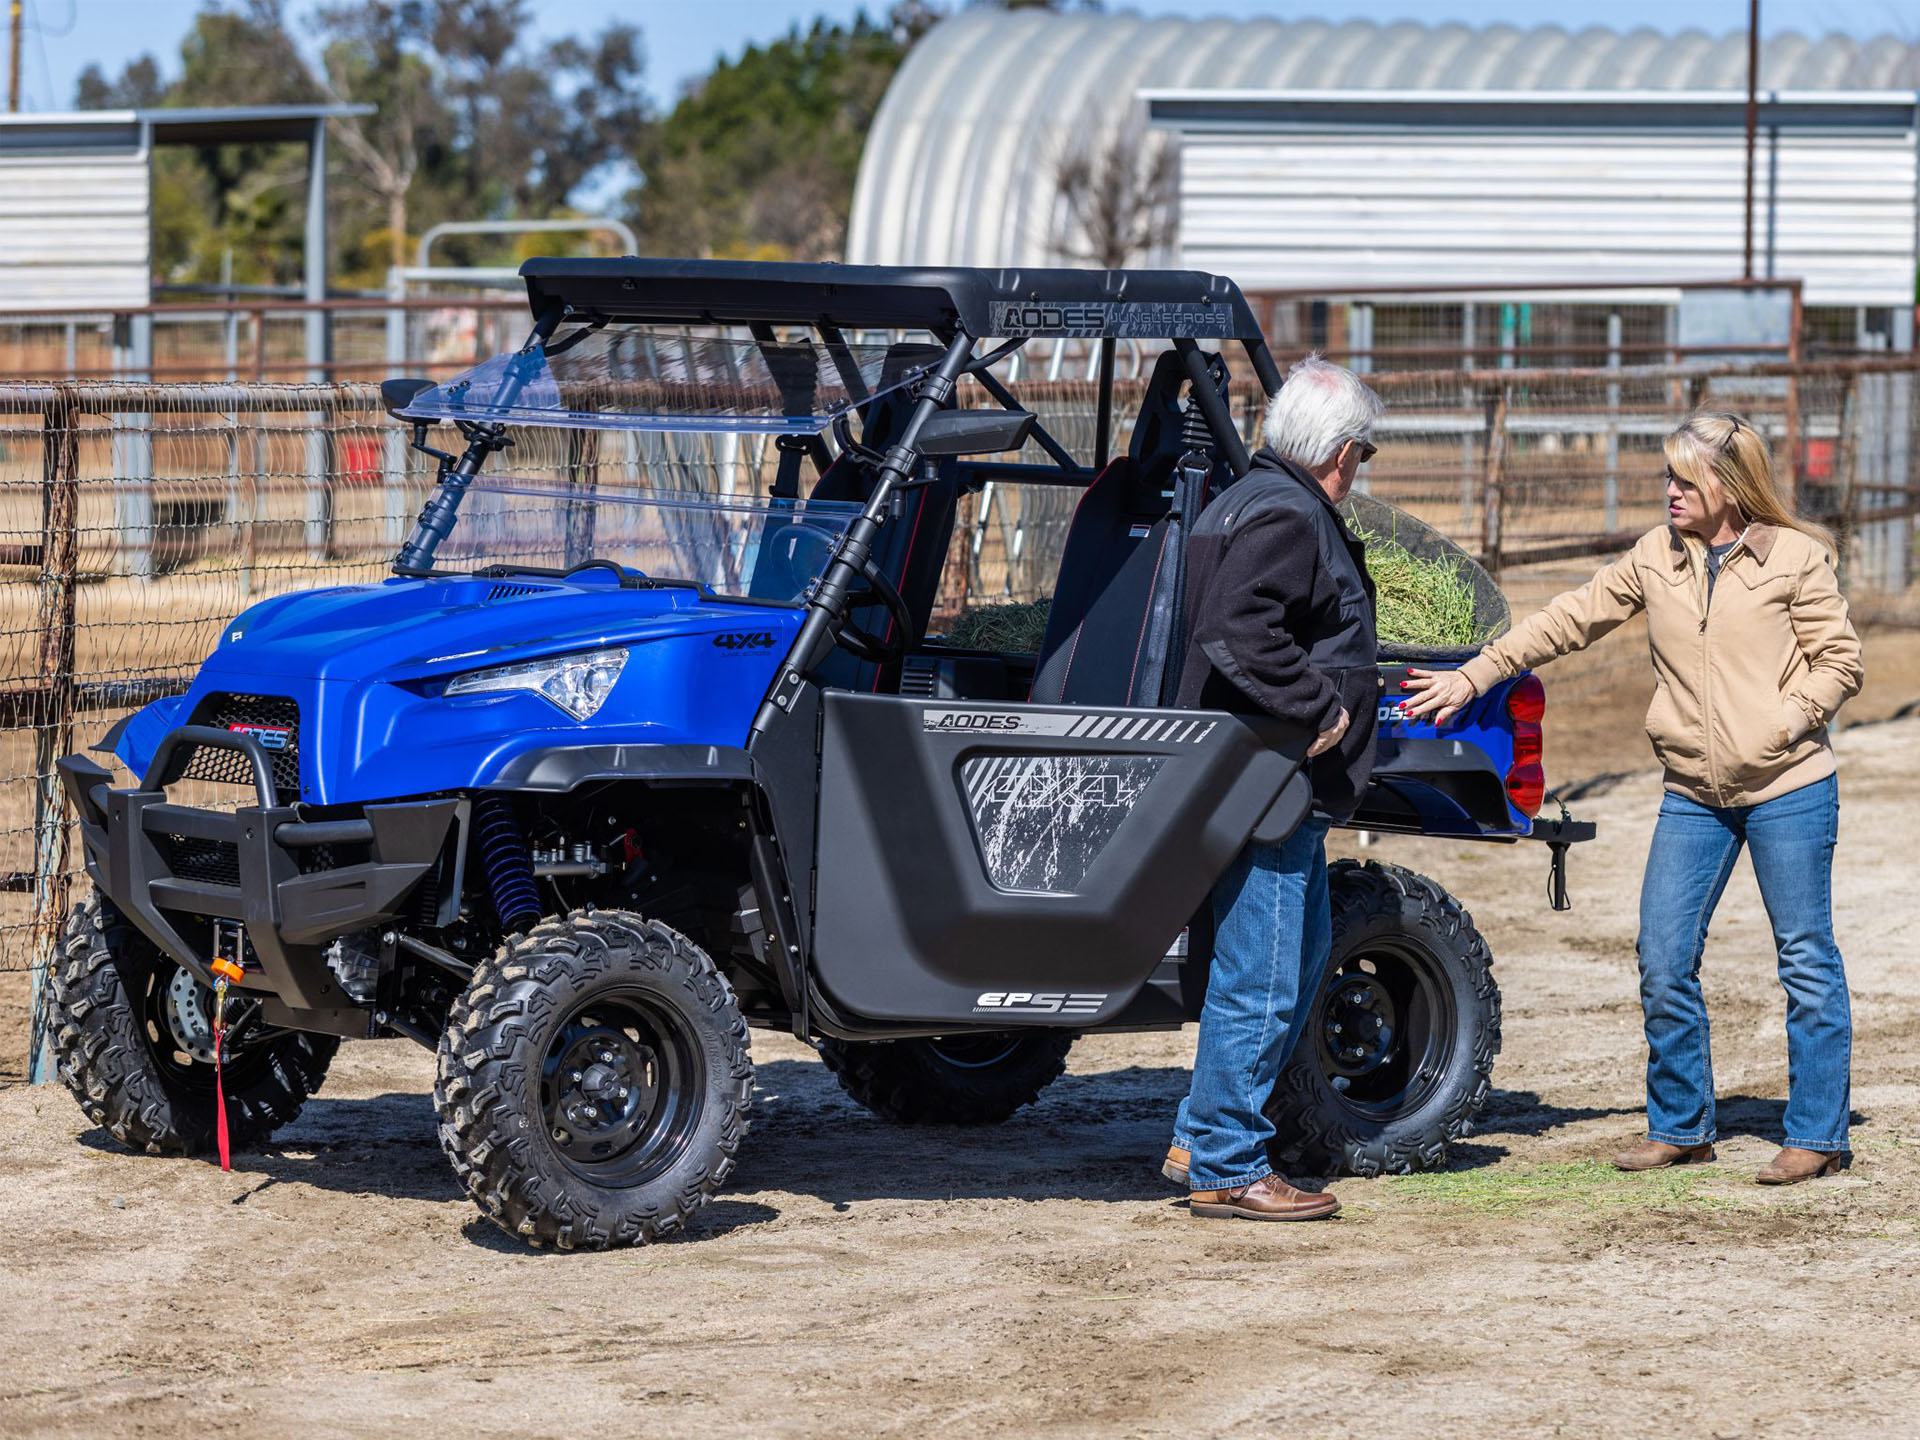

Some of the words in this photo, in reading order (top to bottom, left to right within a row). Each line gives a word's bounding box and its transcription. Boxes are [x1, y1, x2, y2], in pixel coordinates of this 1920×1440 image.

[1002, 307, 1105, 329] AODES
[1112, 312, 1226, 325] JUNGLECROSS
[937, 714, 1022, 730] AODES
